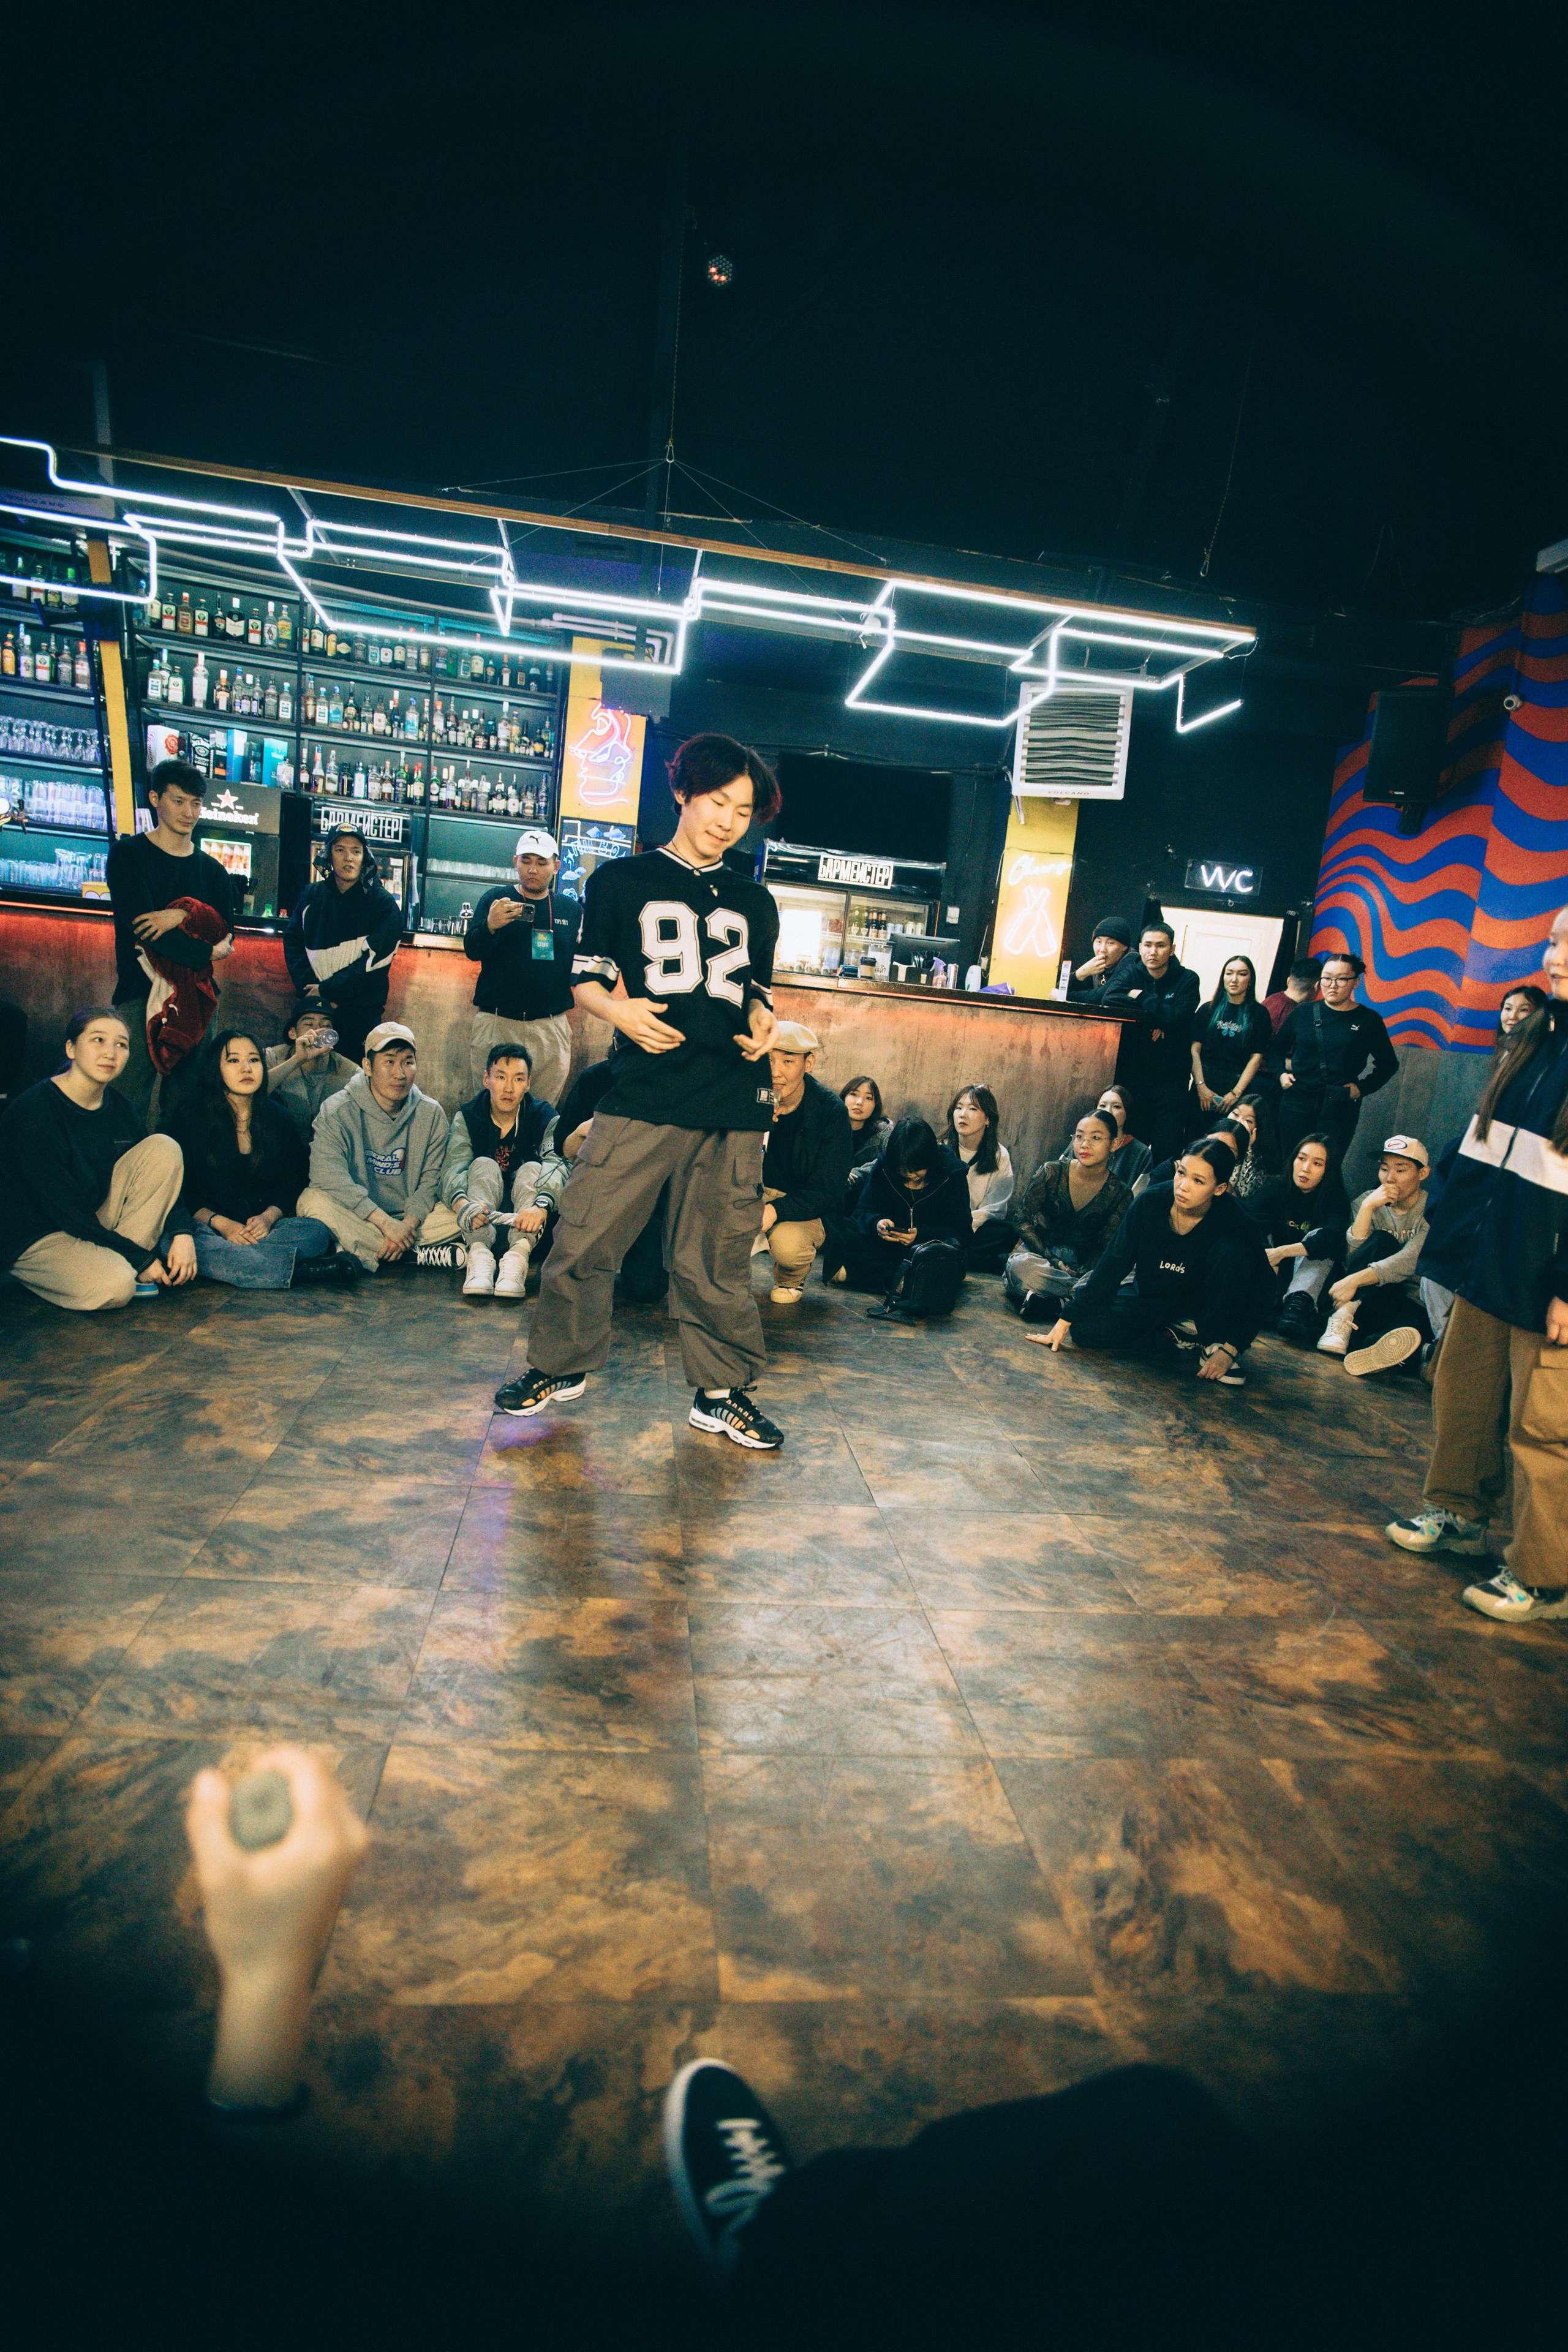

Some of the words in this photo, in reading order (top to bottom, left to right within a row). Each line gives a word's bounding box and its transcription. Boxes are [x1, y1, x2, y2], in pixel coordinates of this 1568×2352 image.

[818, 855, 891, 886] БАРМЕЙСТЕР
[1200, 864, 1253, 893] WC
[638, 900, 751, 1009] 92
[374, 1166, 402, 1175] CLUB
